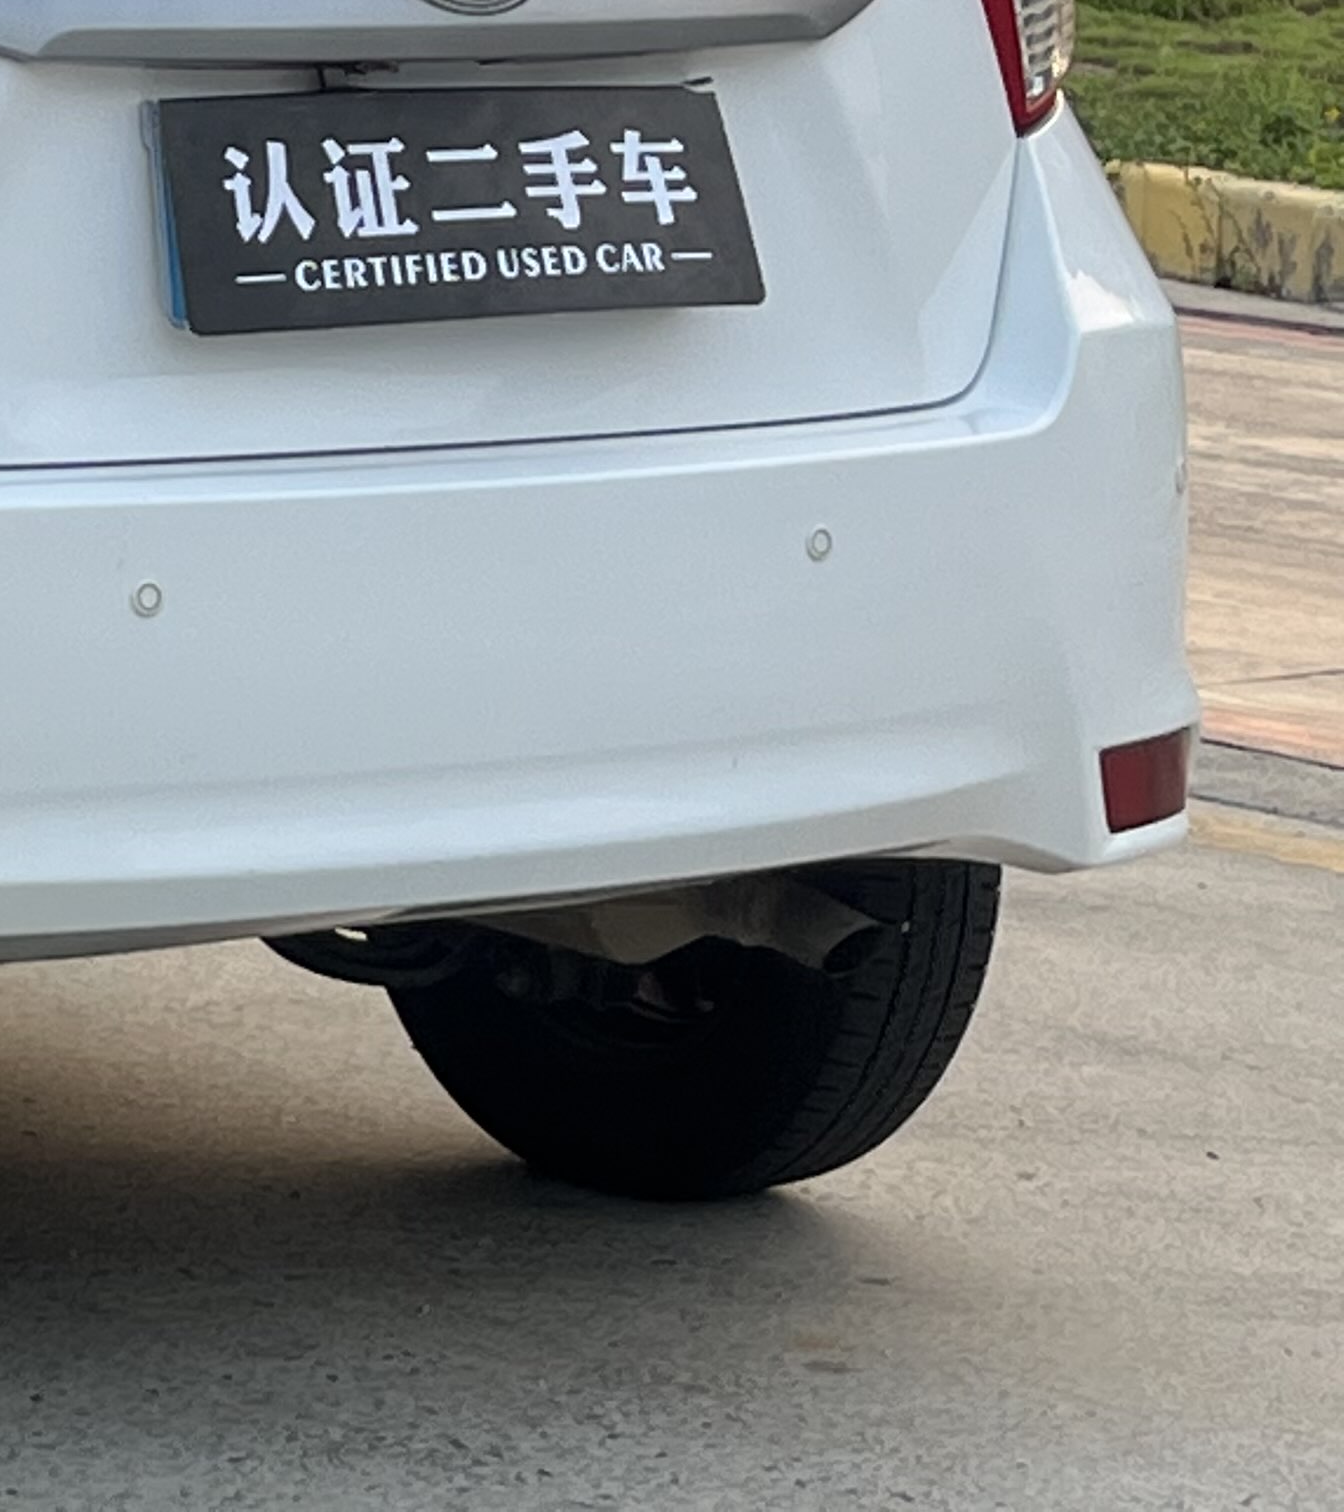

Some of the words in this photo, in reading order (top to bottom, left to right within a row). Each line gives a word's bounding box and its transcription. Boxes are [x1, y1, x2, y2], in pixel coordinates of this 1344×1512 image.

[223, 129, 698, 244] 认证二手车
[294, 250, 487, 291] CERTIFIED
[496, 245, 588, 279] USED
[595, 242, 666, 274] CAR
